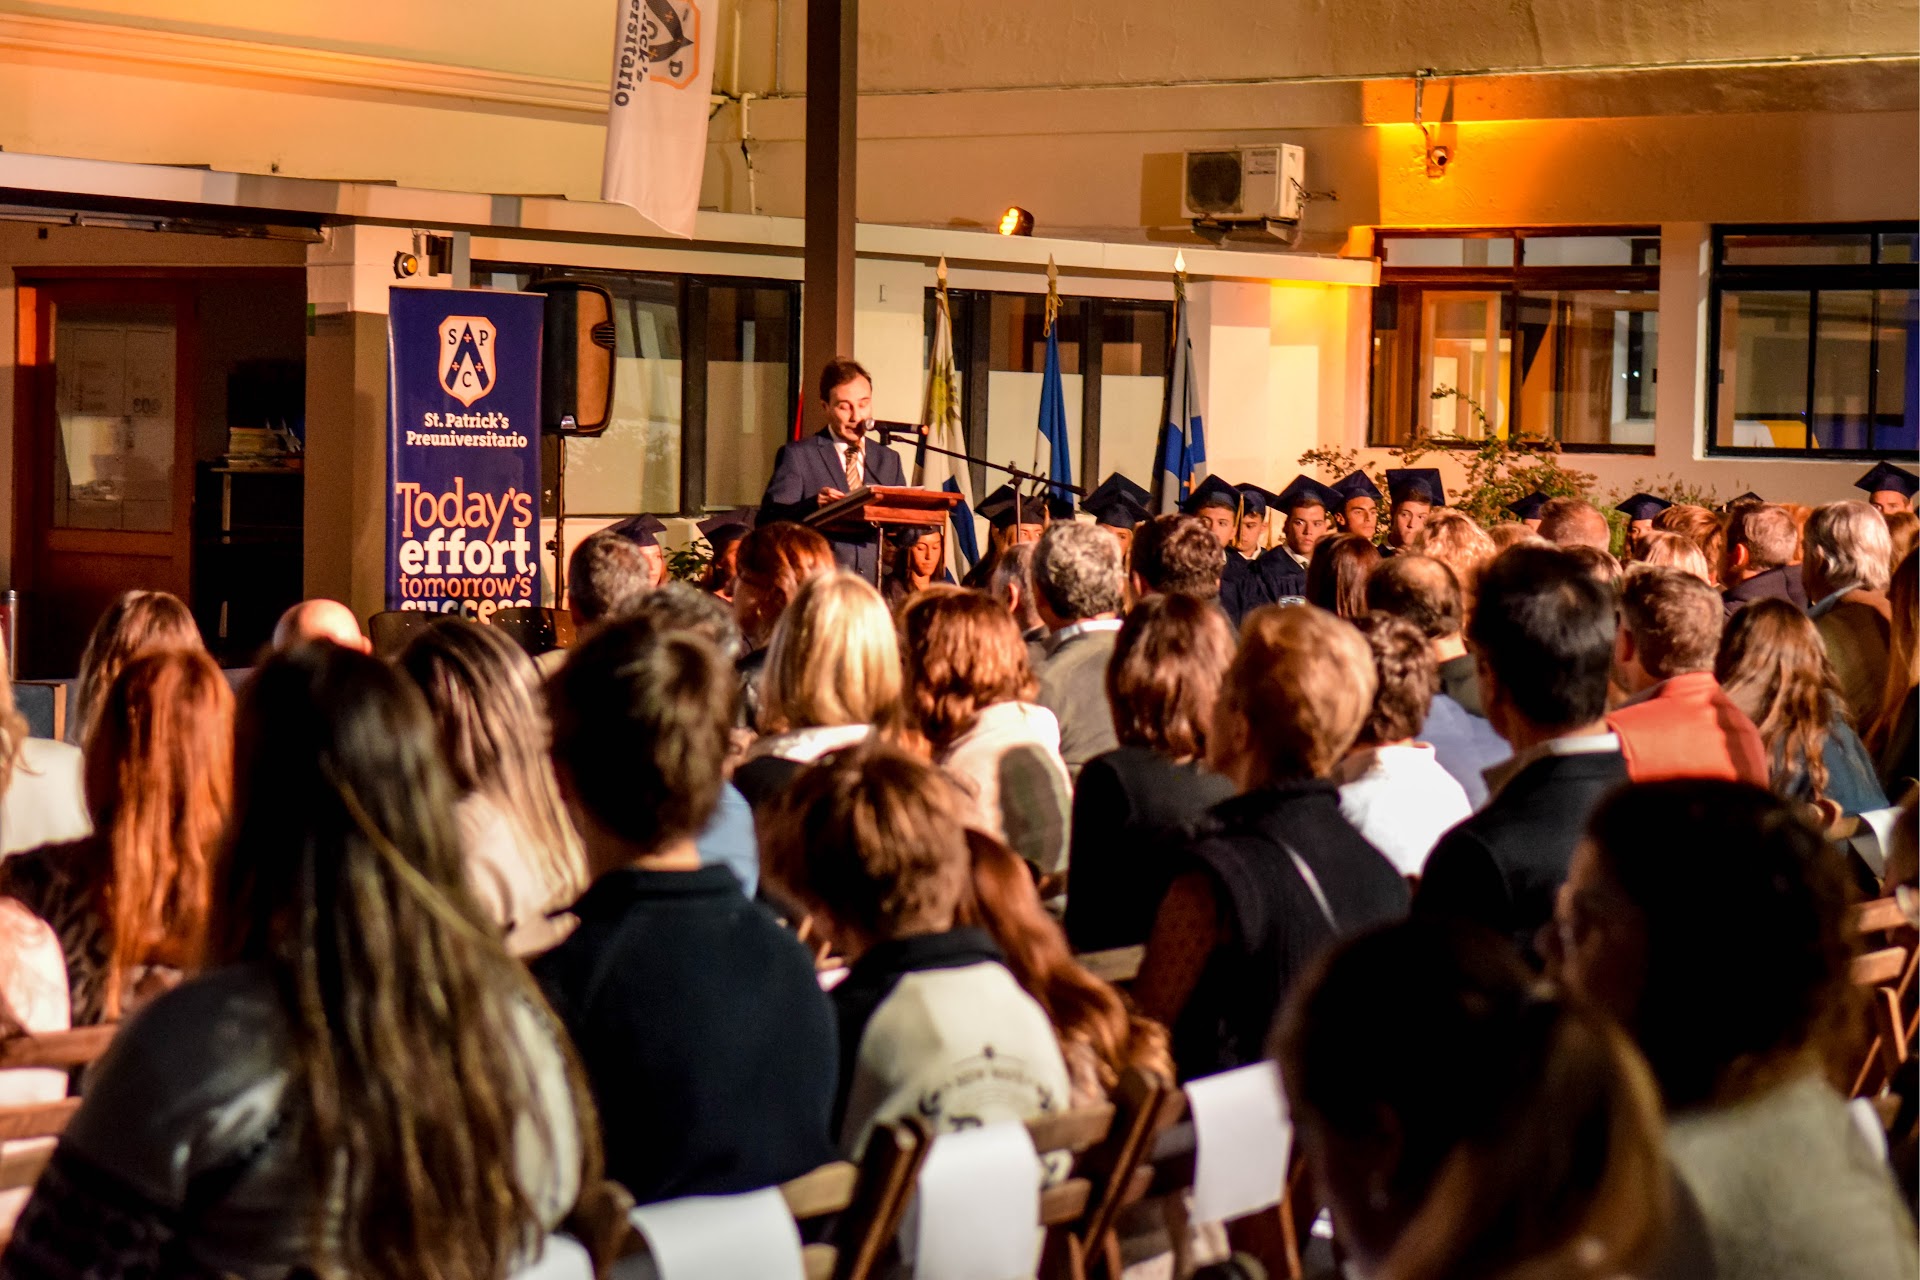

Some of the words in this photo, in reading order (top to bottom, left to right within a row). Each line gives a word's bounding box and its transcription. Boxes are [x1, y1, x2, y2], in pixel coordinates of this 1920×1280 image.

[448, 328, 457, 345] S
[479, 330, 489, 346] P
[462, 371, 472, 387] C
[424, 412, 443, 428] St.
[445, 411, 510, 429] Patrick's
[406, 430, 528, 448] Preuniversitario
[396, 476, 532, 545] Today's
[399, 527, 537, 577] effort,
[399, 573, 532, 598] tomorrow's
